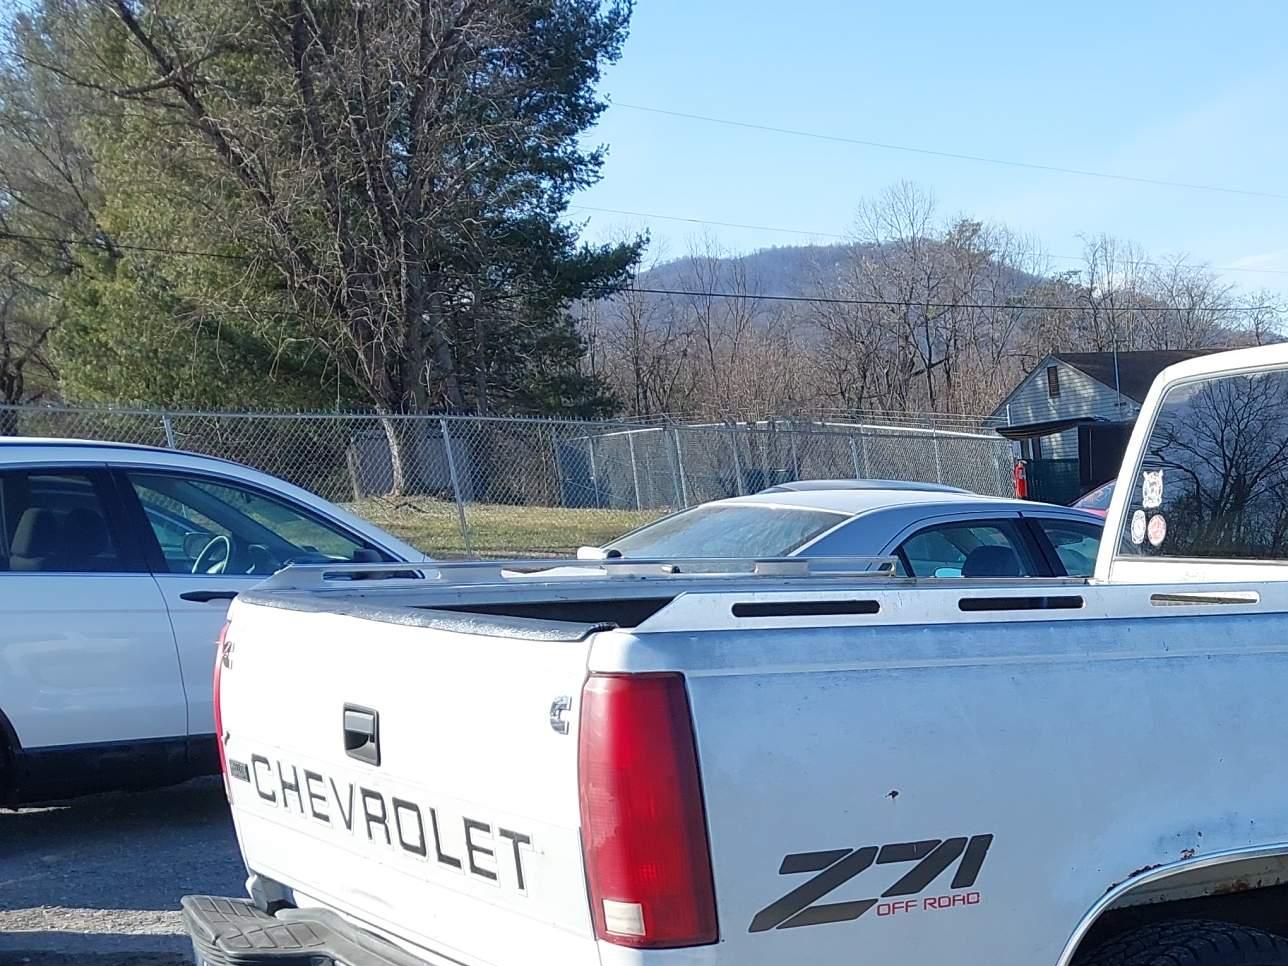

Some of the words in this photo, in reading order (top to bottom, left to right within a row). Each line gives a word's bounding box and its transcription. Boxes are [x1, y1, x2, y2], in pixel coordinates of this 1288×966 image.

[251, 754, 531, 890] CHEVROLET
[749, 833, 994, 933] Z71
[876, 899, 920, 917] OFF
[923, 891, 981, 911] ROAD
